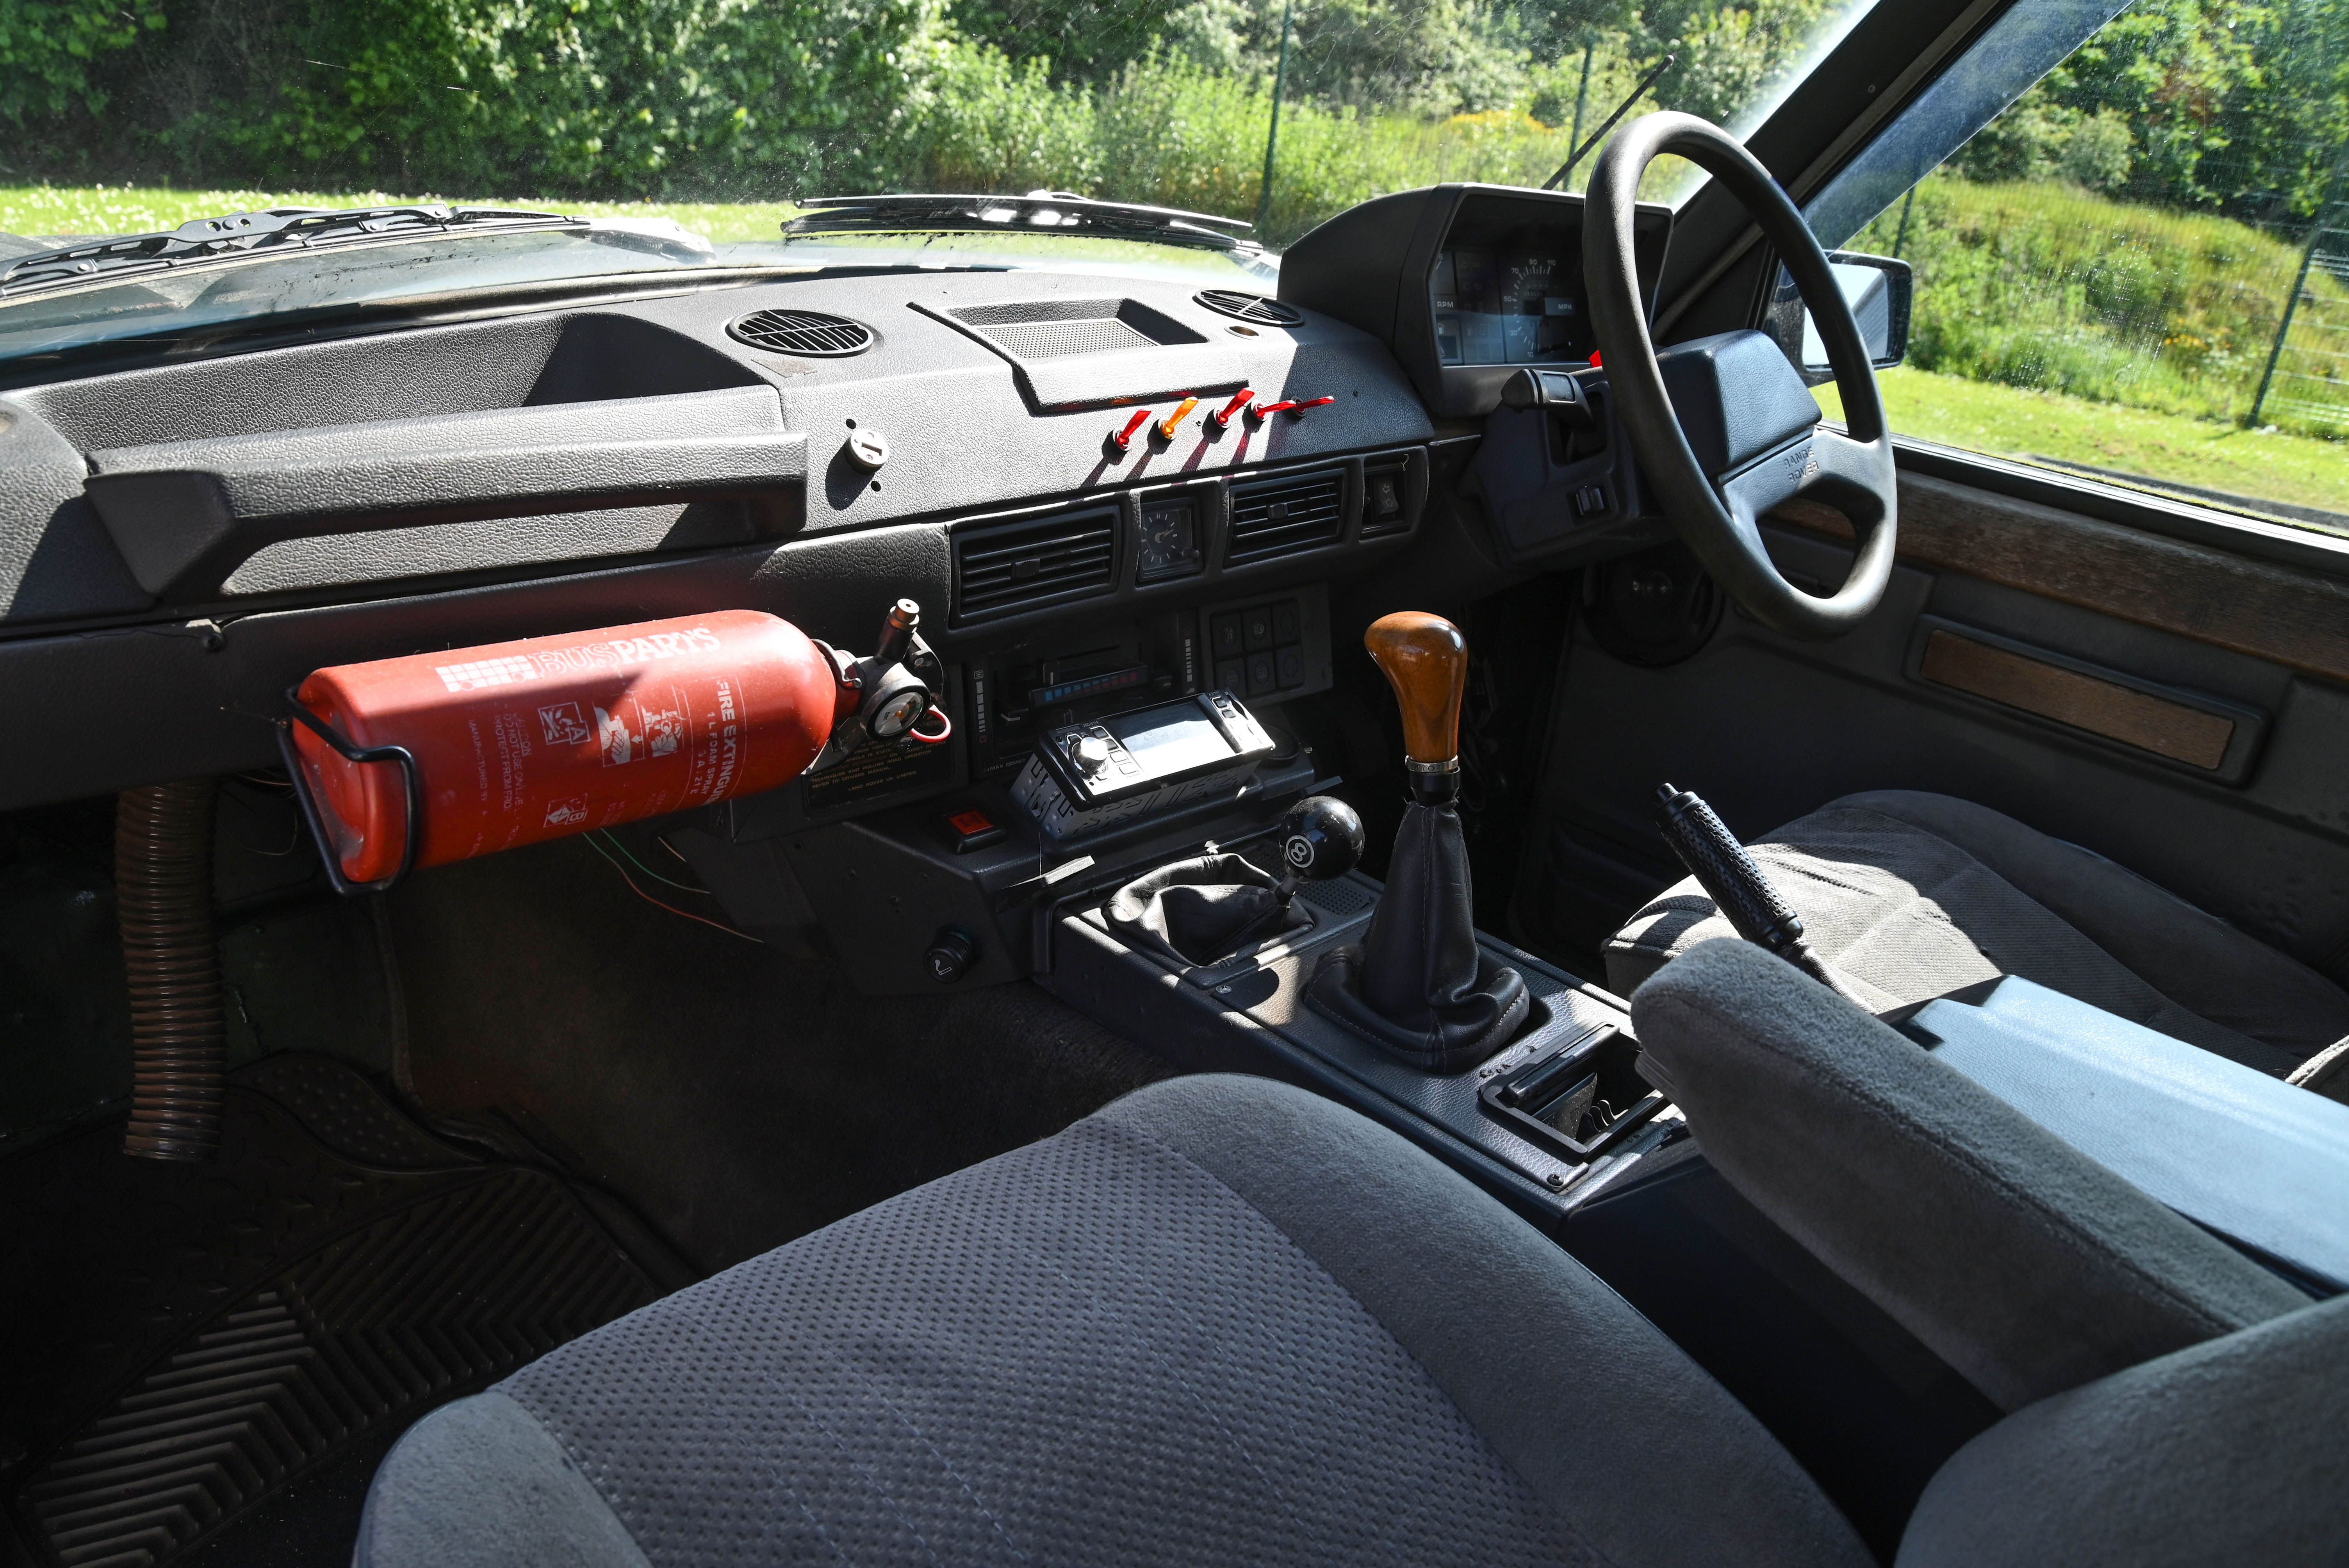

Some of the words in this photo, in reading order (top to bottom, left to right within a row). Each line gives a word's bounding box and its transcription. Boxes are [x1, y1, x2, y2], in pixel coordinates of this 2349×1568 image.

[1783, 446, 1814, 470] RANGE
[1788, 460, 1819, 483] ROVER
[716, 680, 736, 722] FIRE
[883, 711, 891, 720] bar
[508, 729, 520, 748] NOT
[570, 727, 586, 741] A
[709, 732, 718, 764] FOAM
[926, 740, 946, 748] DRIVING
[512, 750, 523, 771] USE
[811, 771, 846, 782] TECHNIQUES
[862, 762, 884, 770] ROLLING
[904, 749, 932, 759] OPERATION
[844, 754, 866, 763] EHICLE
[1006, 759, 1026, 767] DEMIST
[502, 761, 512, 789] FROM
[700, 767, 715, 794] SPRAY
[812, 780, 830, 789] REFER
[842, 772, 866, 781] DRIVERS
[866, 779, 884, 787] ROVER
[569, 812, 585, 822] B
[1290, 842, 1307, 862] 8
